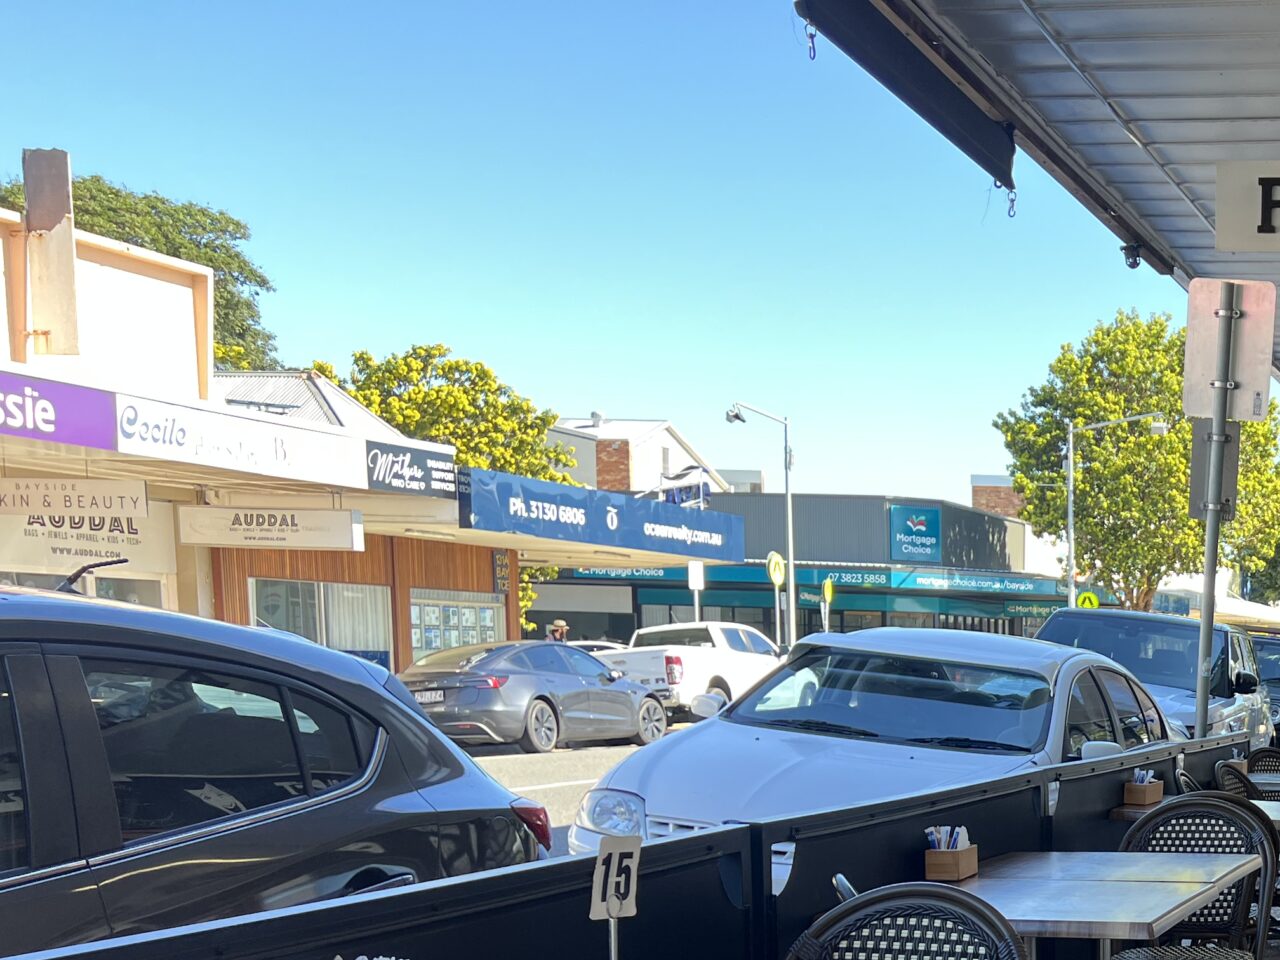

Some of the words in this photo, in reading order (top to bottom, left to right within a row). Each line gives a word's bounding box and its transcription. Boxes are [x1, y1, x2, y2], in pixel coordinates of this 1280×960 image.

[119, 405, 187, 447] Cecile
[15, 483, 77, 491] BAYSIDE
[42, 494, 52, 508] &
[64, 495, 140, 510] BEAUTY
[509, 497, 528, 518] Ph.
[530, 500, 557, 522] 3130
[558, 503, 586, 527] 6806
[27, 514, 139, 535] AUDDAL
[231, 513, 298, 527] AUDDAL
[896, 533, 936, 546] Mortgage
[51, 546, 121, 559] WWW.AUDDAL.COM
[902, 544, 932, 554] Choice
[590, 567, 632, 578] Mortgage
[633, 567, 664, 577] Choice
[828, 572, 840, 582] 07
[840, 573, 862, 583] 3823
[863, 574, 887, 584] 5858
[1015, 605, 1050, 615] Mortgage
[601, 851, 634, 903] 15
